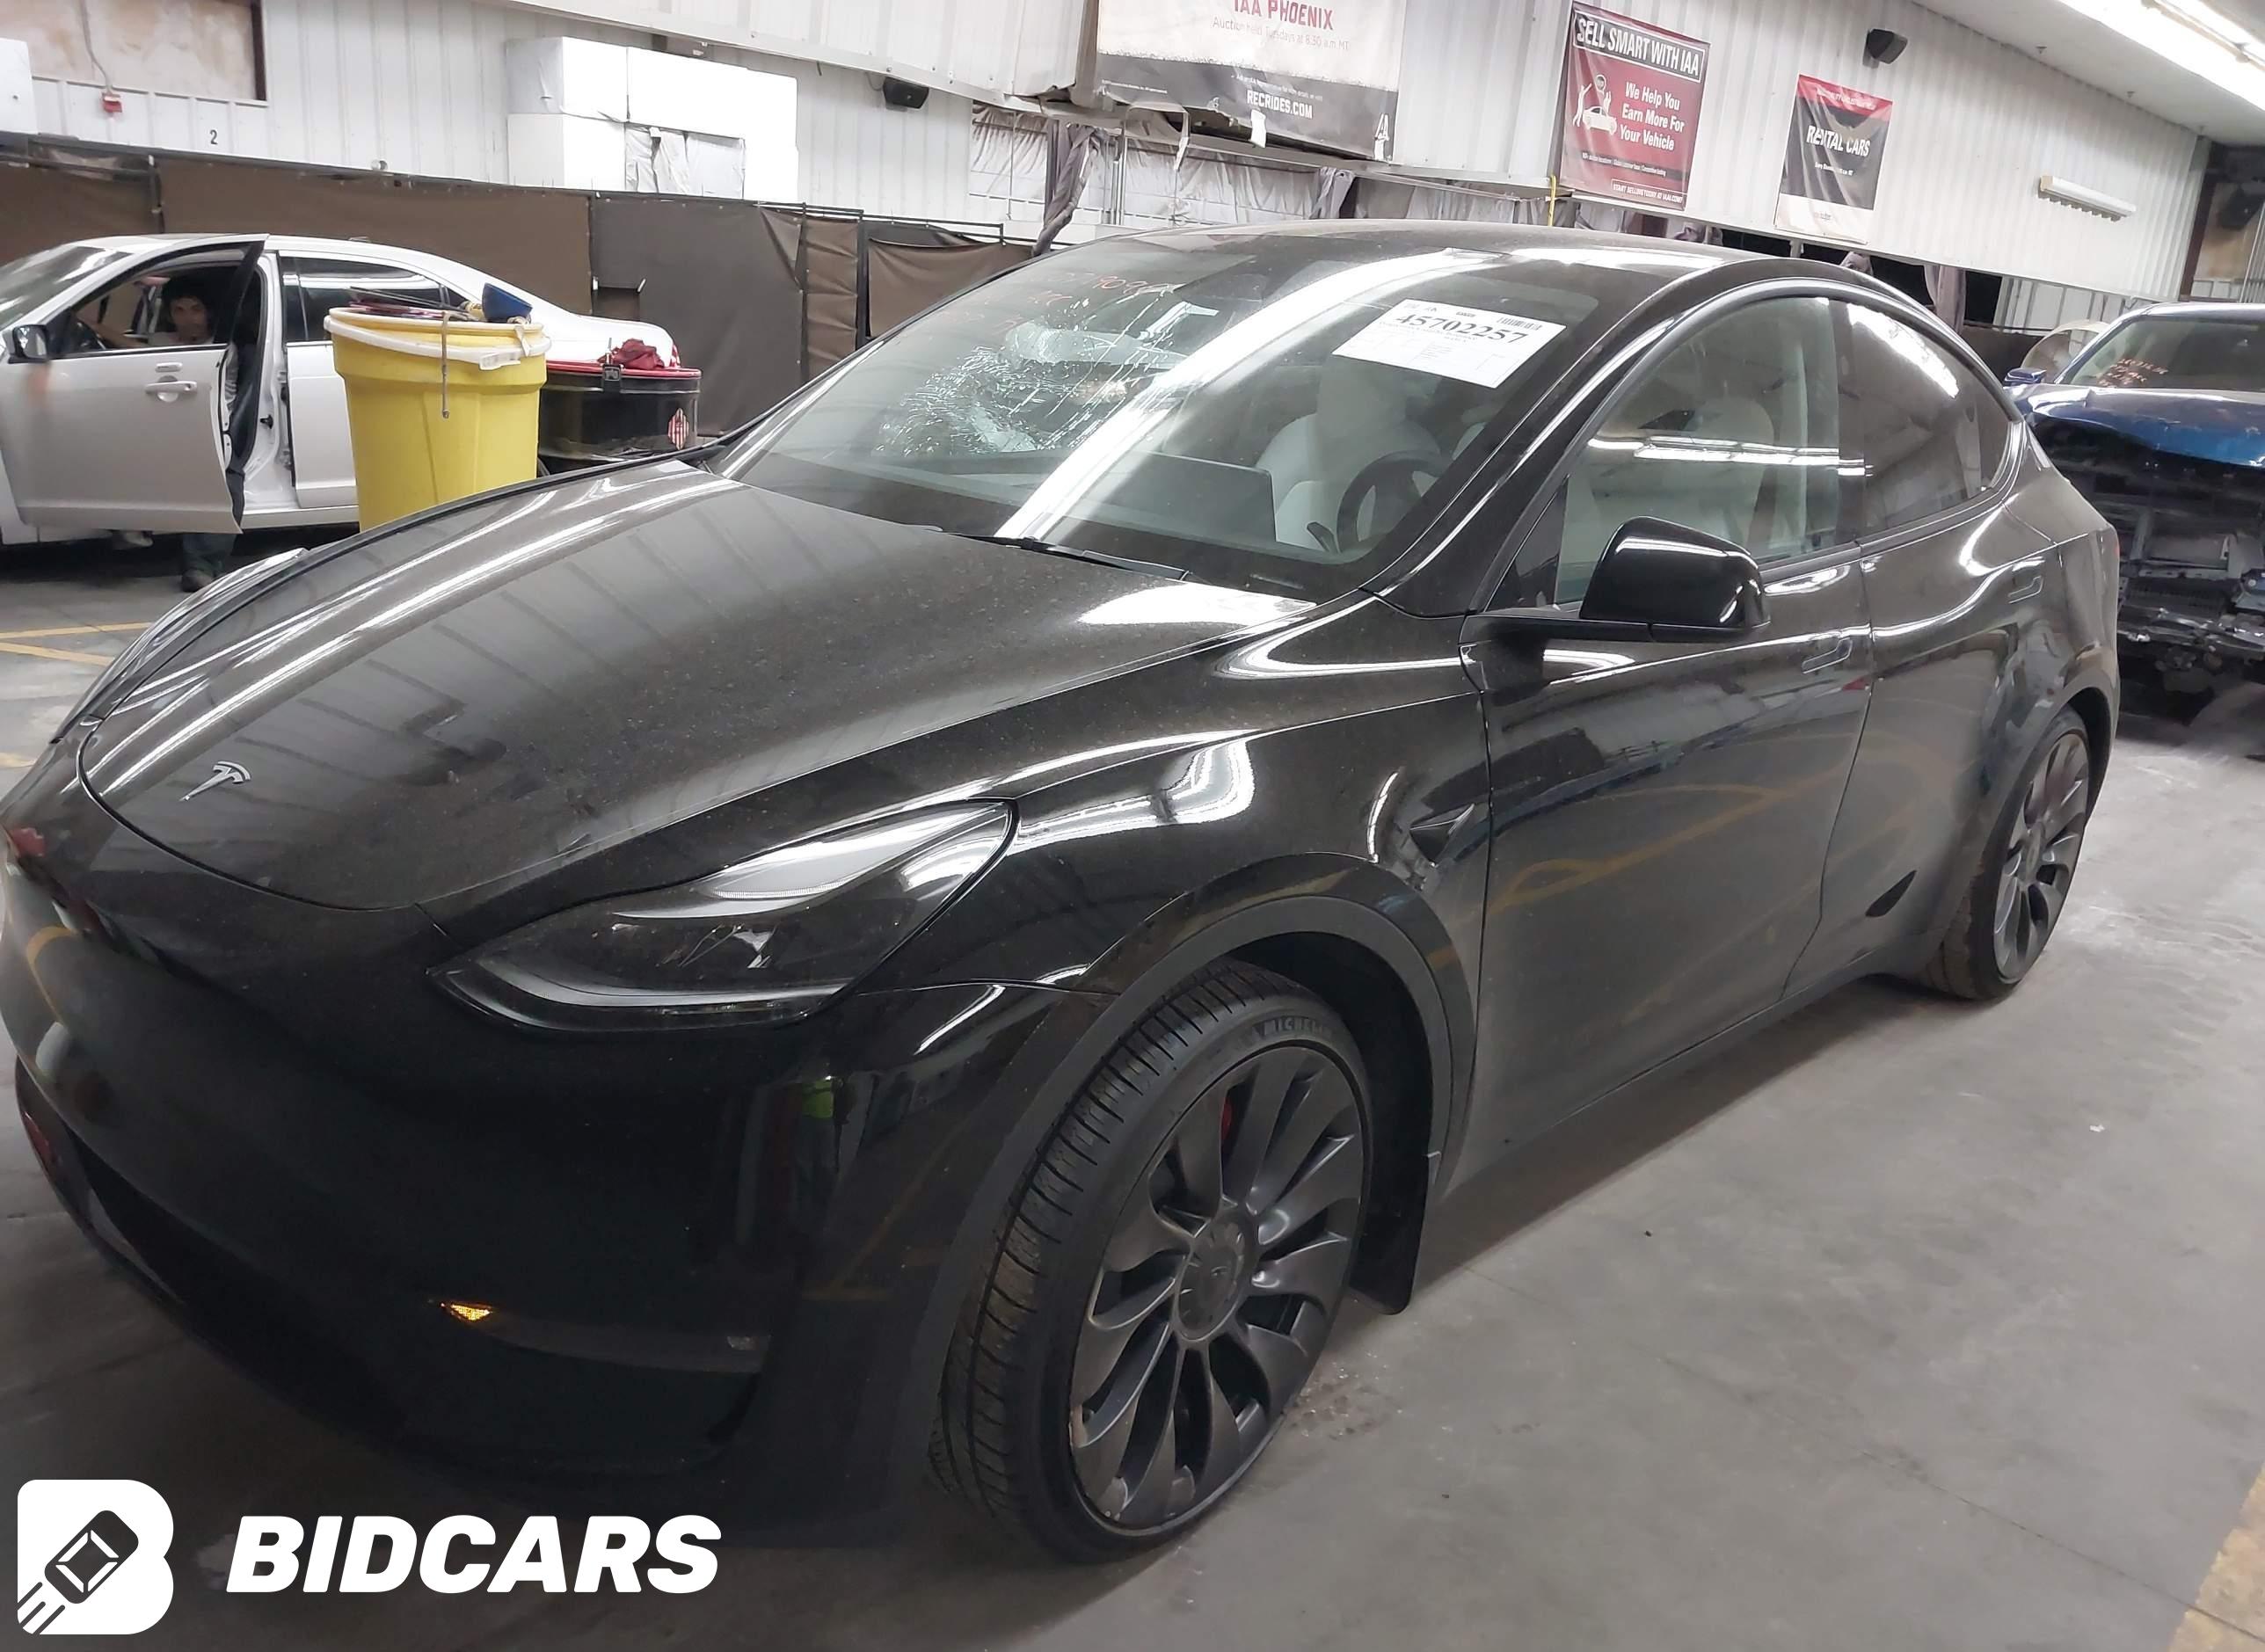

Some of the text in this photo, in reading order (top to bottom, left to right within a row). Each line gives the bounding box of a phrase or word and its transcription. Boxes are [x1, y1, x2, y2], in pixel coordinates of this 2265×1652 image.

[1267, 0, 1334, 31] PHOENIX
[1577, 18, 1701, 76] SELL SMART WITH IAA
[1247, 90, 1313, 120] RECRIDES.COM
[1625, 82, 1680, 111] We Help You
[1622, 104, 1685, 133] Earn More For
[209, 129, 218, 145] 2
[1620, 125, 1675, 150] Your Vehicle
[1806, 125, 1871, 157] RENTAL CARS
[1395, 314, 1528, 344] 45702257
